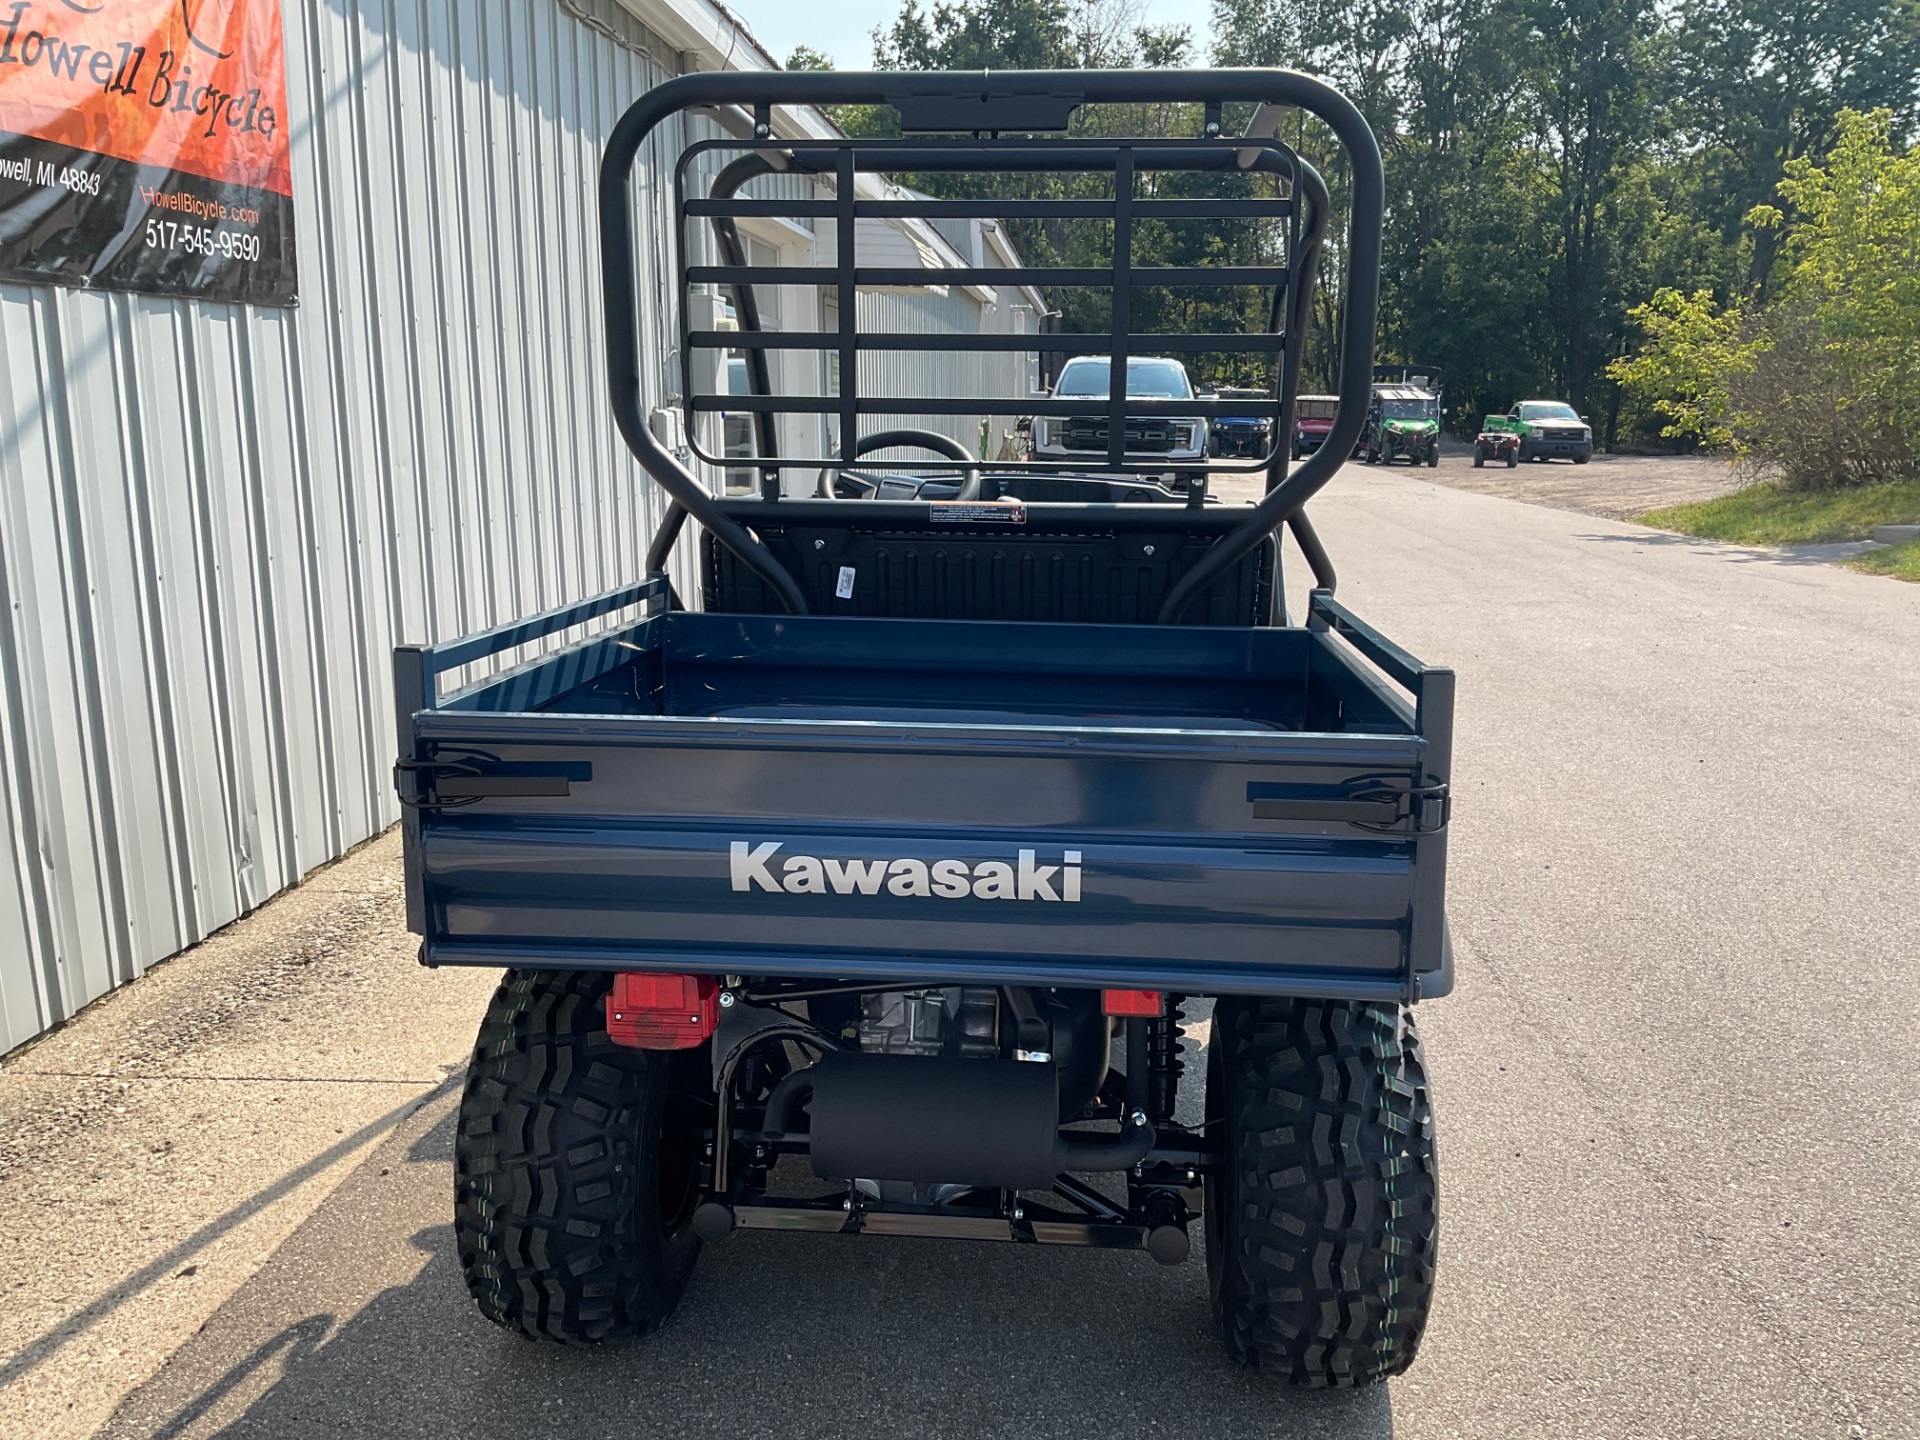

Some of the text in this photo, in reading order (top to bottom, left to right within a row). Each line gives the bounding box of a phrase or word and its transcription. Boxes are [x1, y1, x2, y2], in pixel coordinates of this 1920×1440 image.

[148, 50, 276, 142] Bicycle
[36, 161, 55, 187] MI
[60, 167, 100, 195] 48843
[140, 185, 259, 224] HowellBicycle.com
[146, 219, 259, 262] 517-545-9590
[730, 841, 1082, 902] Kawasaki
